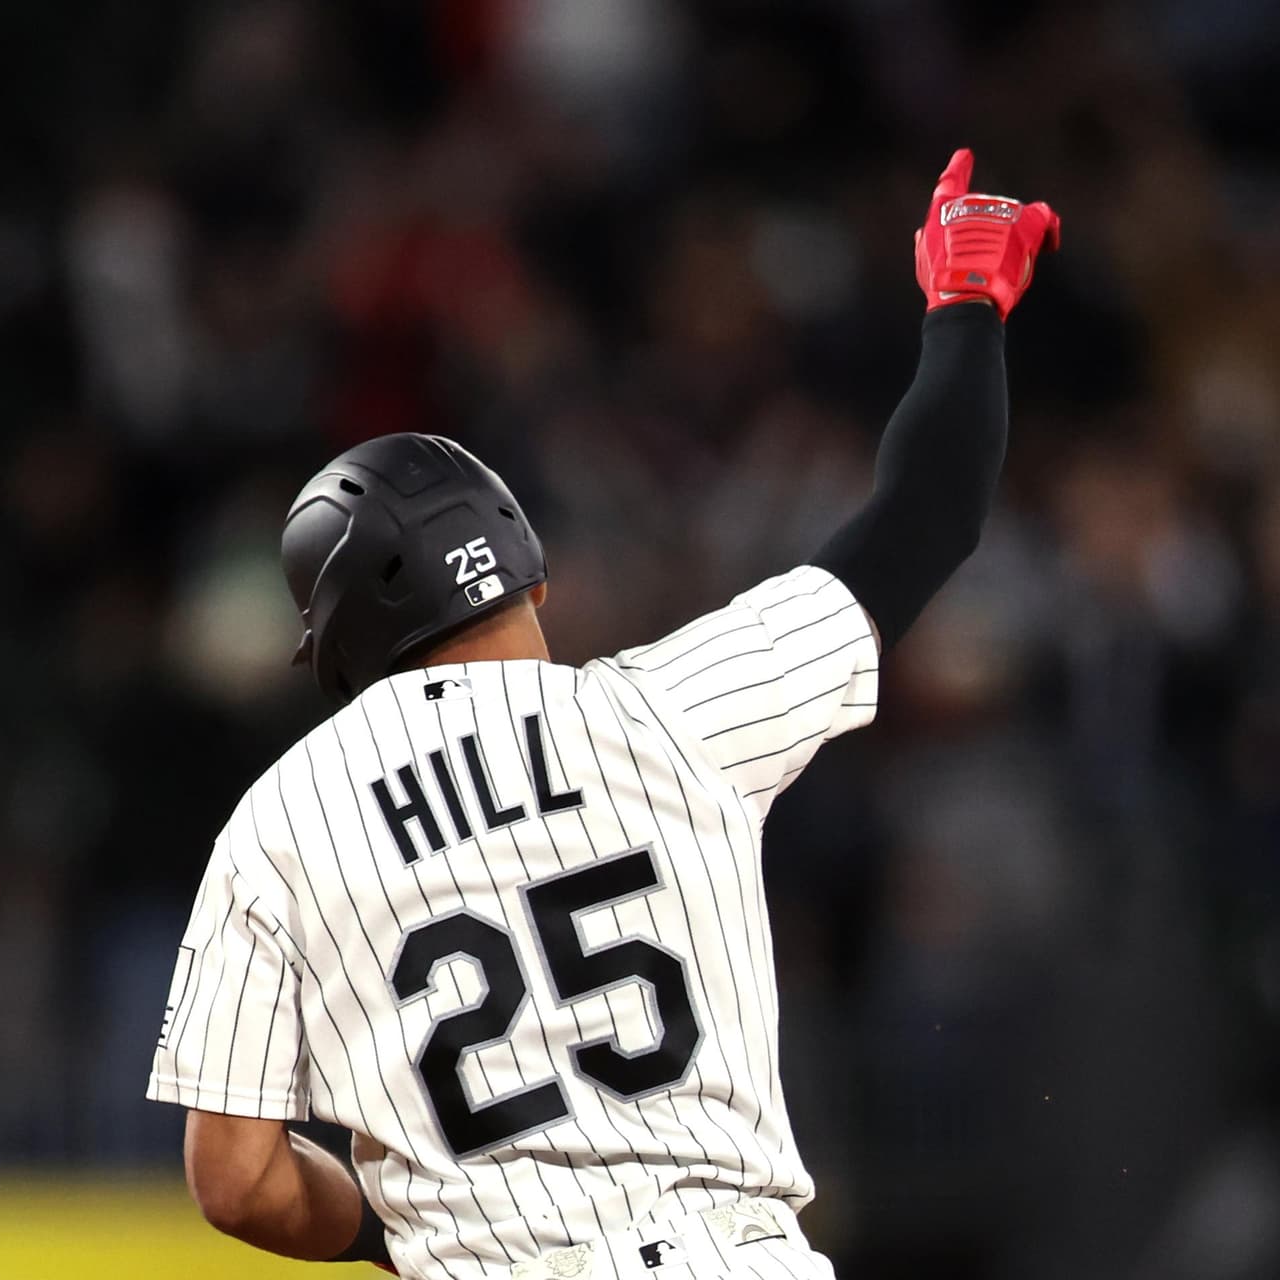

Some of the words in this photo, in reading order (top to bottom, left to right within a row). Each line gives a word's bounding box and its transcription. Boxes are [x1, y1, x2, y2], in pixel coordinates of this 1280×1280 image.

[444, 536, 497, 585] 25
[367, 711, 587, 869] HILL
[385, 841, 706, 1163] 25
